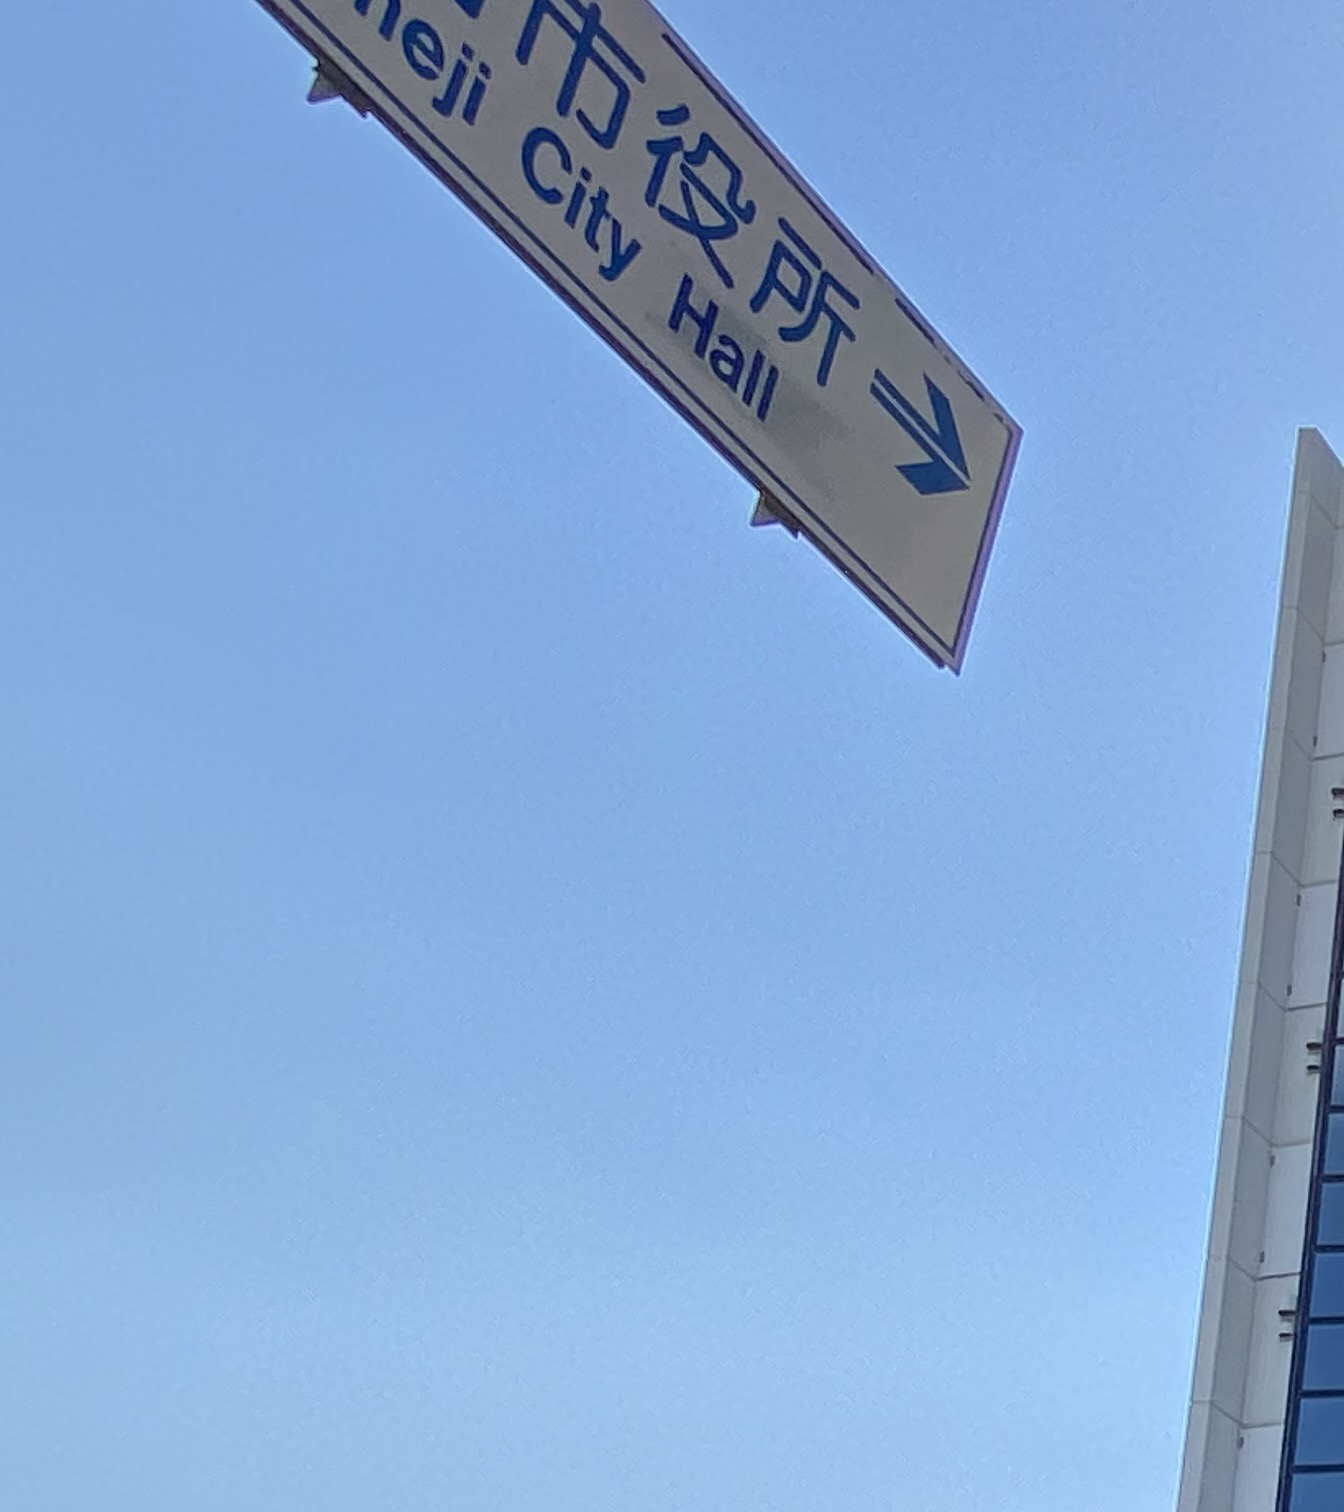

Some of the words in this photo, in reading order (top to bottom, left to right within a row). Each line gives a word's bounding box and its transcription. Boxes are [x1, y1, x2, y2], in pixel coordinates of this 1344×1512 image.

[455, 0, 861, 387] 市役所
[521, 127, 642, 281] City
[667, 275, 779, 423] Hall
